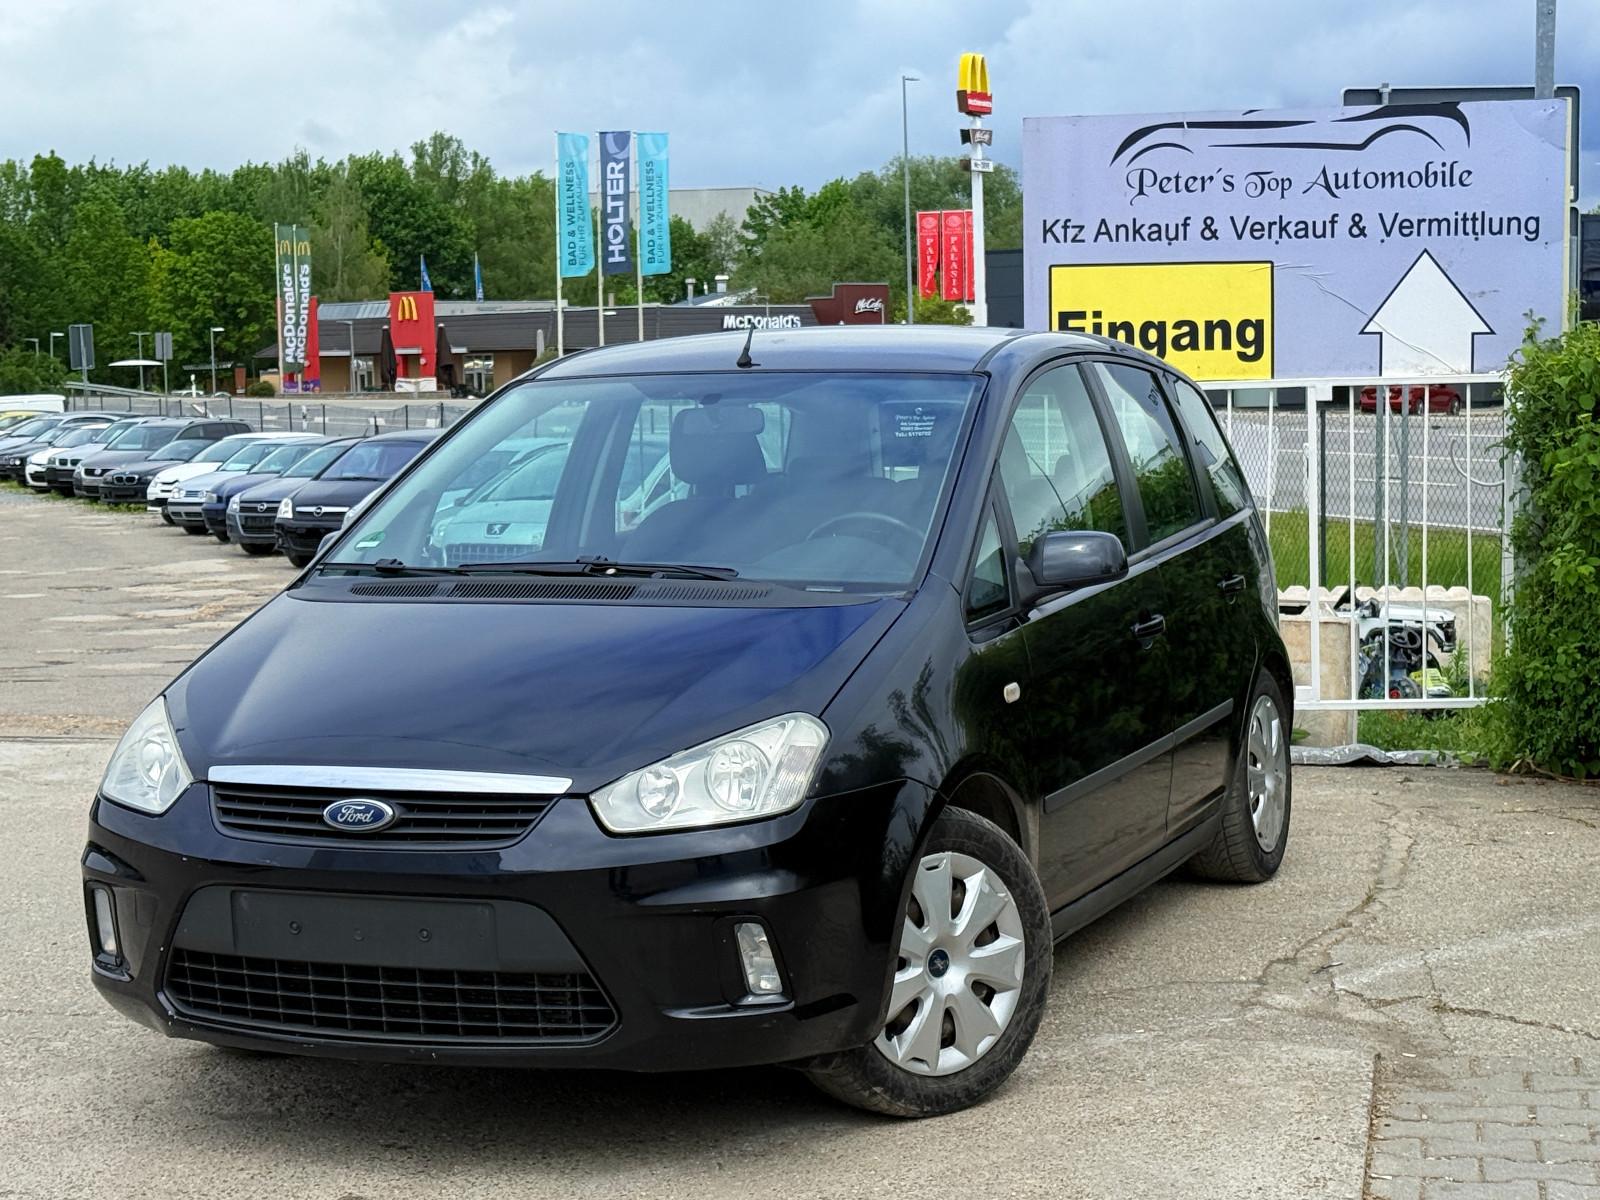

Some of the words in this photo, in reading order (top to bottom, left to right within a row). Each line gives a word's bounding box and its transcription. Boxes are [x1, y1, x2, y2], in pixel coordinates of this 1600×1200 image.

[645, 160, 655, 225] WELLNESS
[1244, 171, 1293, 200] Top
[1302, 161, 1473, 199] Automobile
[565, 161, 576, 226] WELLNESS
[606, 161, 626, 263] HOLTER
[567, 230, 576, 238] &
[576, 225, 586, 243] IHR
[647, 228, 655, 236] &
[1042, 218, 1086, 243] Kfz
[1093, 216, 1191, 243] Ankauf
[1200, 216, 1219, 241] &
[1230, 213, 1339, 241] Verkauf
[1348, 212, 1368, 239] &
[1378, 210, 1541, 242] Vermittlung
[567, 241, 577, 266] BAD
[647, 239, 656, 264] BAD
[723, 314, 801, 329] McDonald's
[337, 804, 375, 823] Ford
